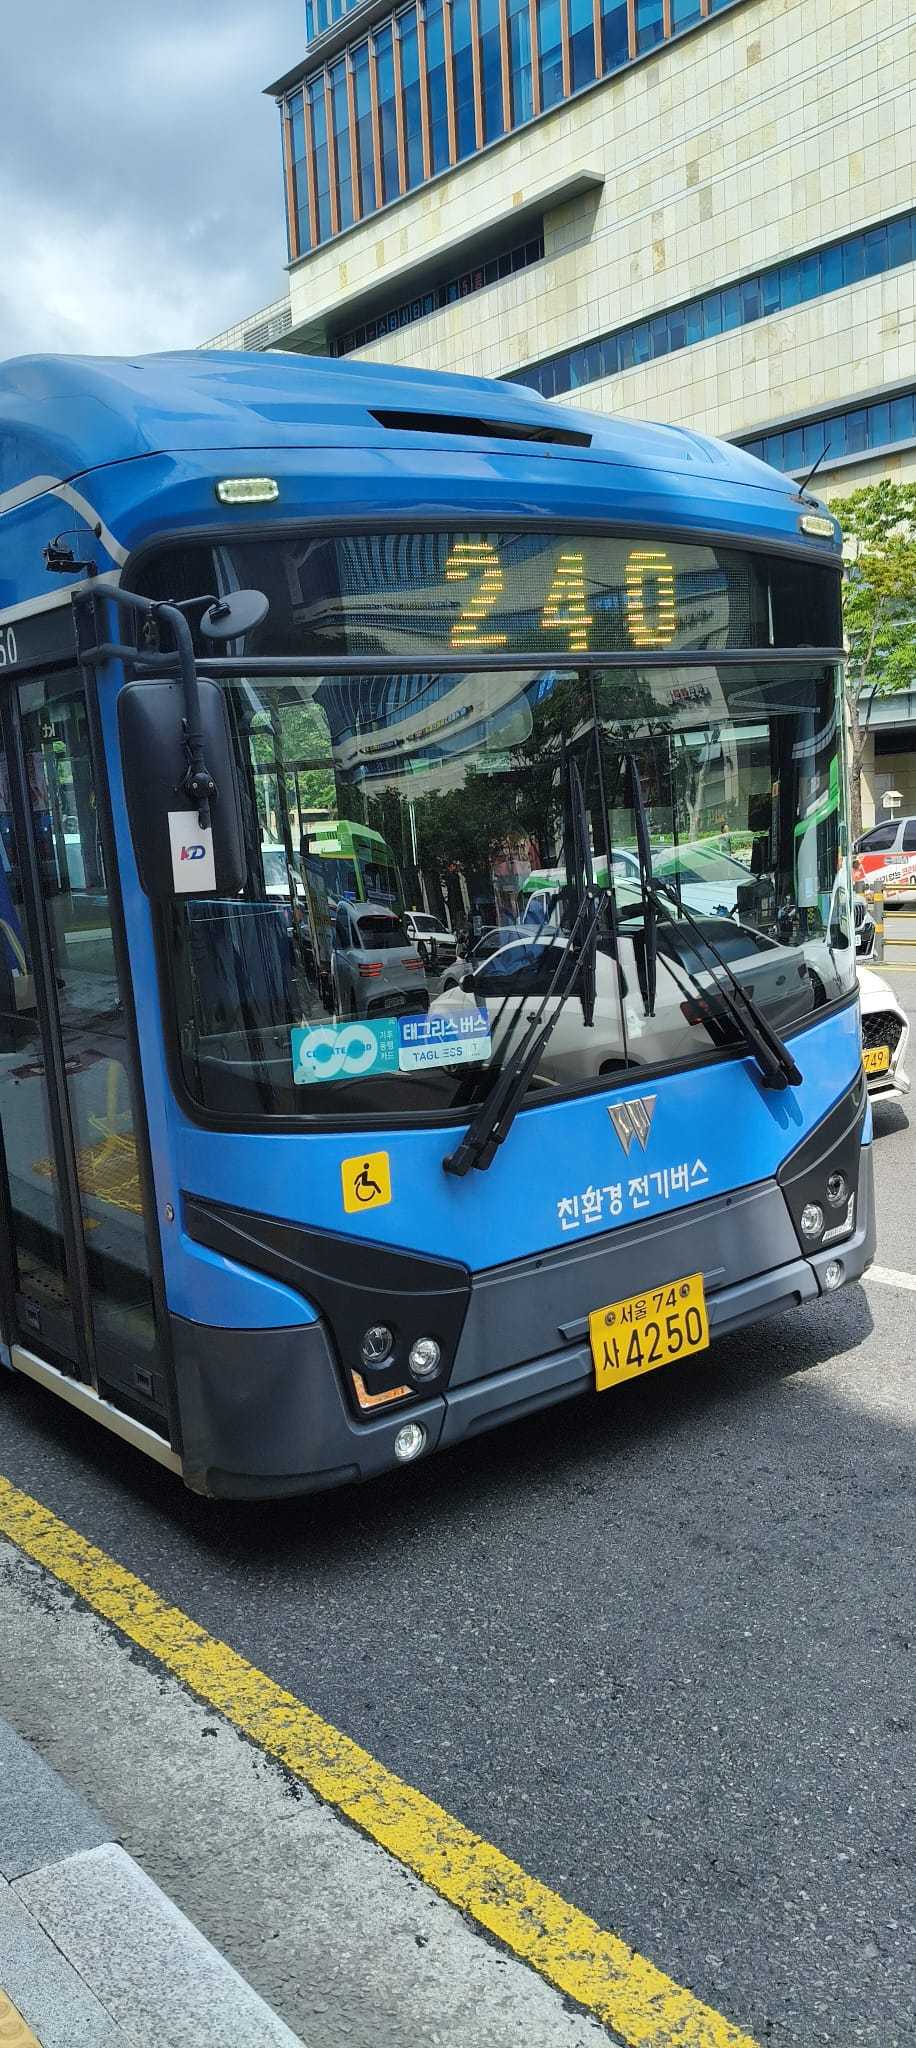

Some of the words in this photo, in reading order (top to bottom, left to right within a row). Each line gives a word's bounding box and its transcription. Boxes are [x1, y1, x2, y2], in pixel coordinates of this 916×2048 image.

[446, 543, 676, 650] 240
[403, 1019, 458, 1041] 태그리스
[460, 1015, 488, 1034] 버스
[413, 1047, 463, 1062] TAGLESS
[557, 1183, 623, 1231] 친환경
[628, 1159, 709, 1209] 전기버스
[620, 1299, 648, 1325] 서울
[652, 1288, 677, 1313] 74
[602, 1338, 620, 1371] 사
[626, 1305, 703, 1368] 4250
